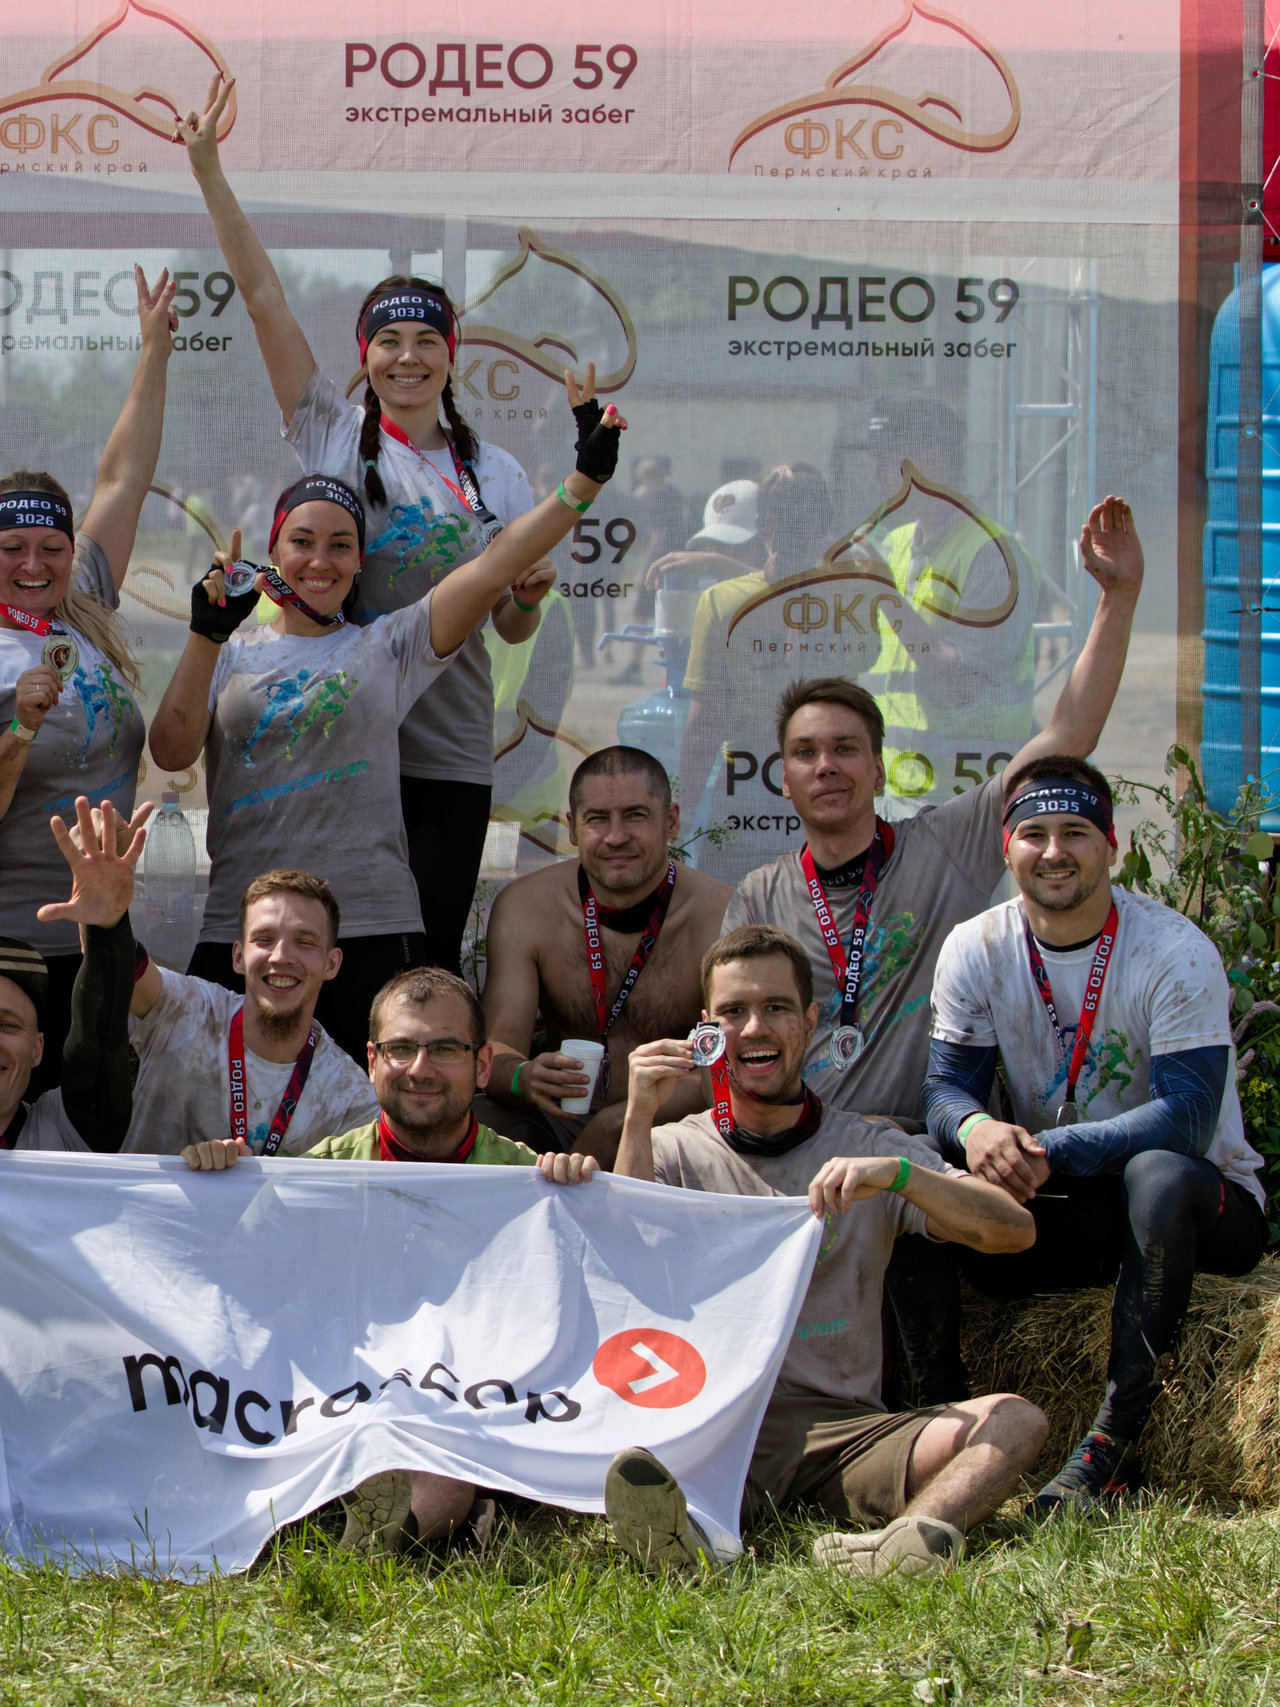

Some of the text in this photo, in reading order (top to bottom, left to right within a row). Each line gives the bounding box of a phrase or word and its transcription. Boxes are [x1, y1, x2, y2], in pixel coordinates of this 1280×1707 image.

[344, 41, 638, 97] РОДЕО 59
[345, 103, 636, 128] экстремальный забег
[0, 112, 120, 156] ФКС
[783, 118, 905, 161] ФКС
[93, 160, 149, 176] край
[753, 164, 933, 181] Пермский край
[171, 271, 236, 317] 59
[372, 294, 443, 315] РОДЕО 59
[726, 275, 1020, 331] РОДЕО 59
[387, 306, 426, 321] 3033
[171, 333, 233, 354] абег
[727, 337, 1018, 361] экстремальный забег
[451, 359, 521, 401] КС
[493, 406, 549, 421] край
[305, 480, 353, 502] РОДЕО
[463, 481, 484, 512] РОДЕО
[15, 512, 55, 527] 3026
[54, 504, 67, 518] 59
[571, 517, 637, 565] 59
[559, 577, 634, 599] забег
[7, 606, 39, 629] РОДЕО 59
[782, 593, 903, 635] ФКС
[753, 639, 866, 655] Пермский
[1036, 799, 1080, 814] 3035
[1081, 791, 1098, 806] 59
[808, 878, 839, 947] РОДЕО 59
[584, 896, 602, 971] РОДЕО 59
[625, 968, 639, 986] 59
[844, 928, 865, 1003] 59 РОДЕО
[1084, 933, 1113, 1011] РОДЕО 59
[230, 1059, 246, 1136] РОДЕО 59
[717, 1101, 729, 1115] 59
[265, 1132, 282, 1152] 59
